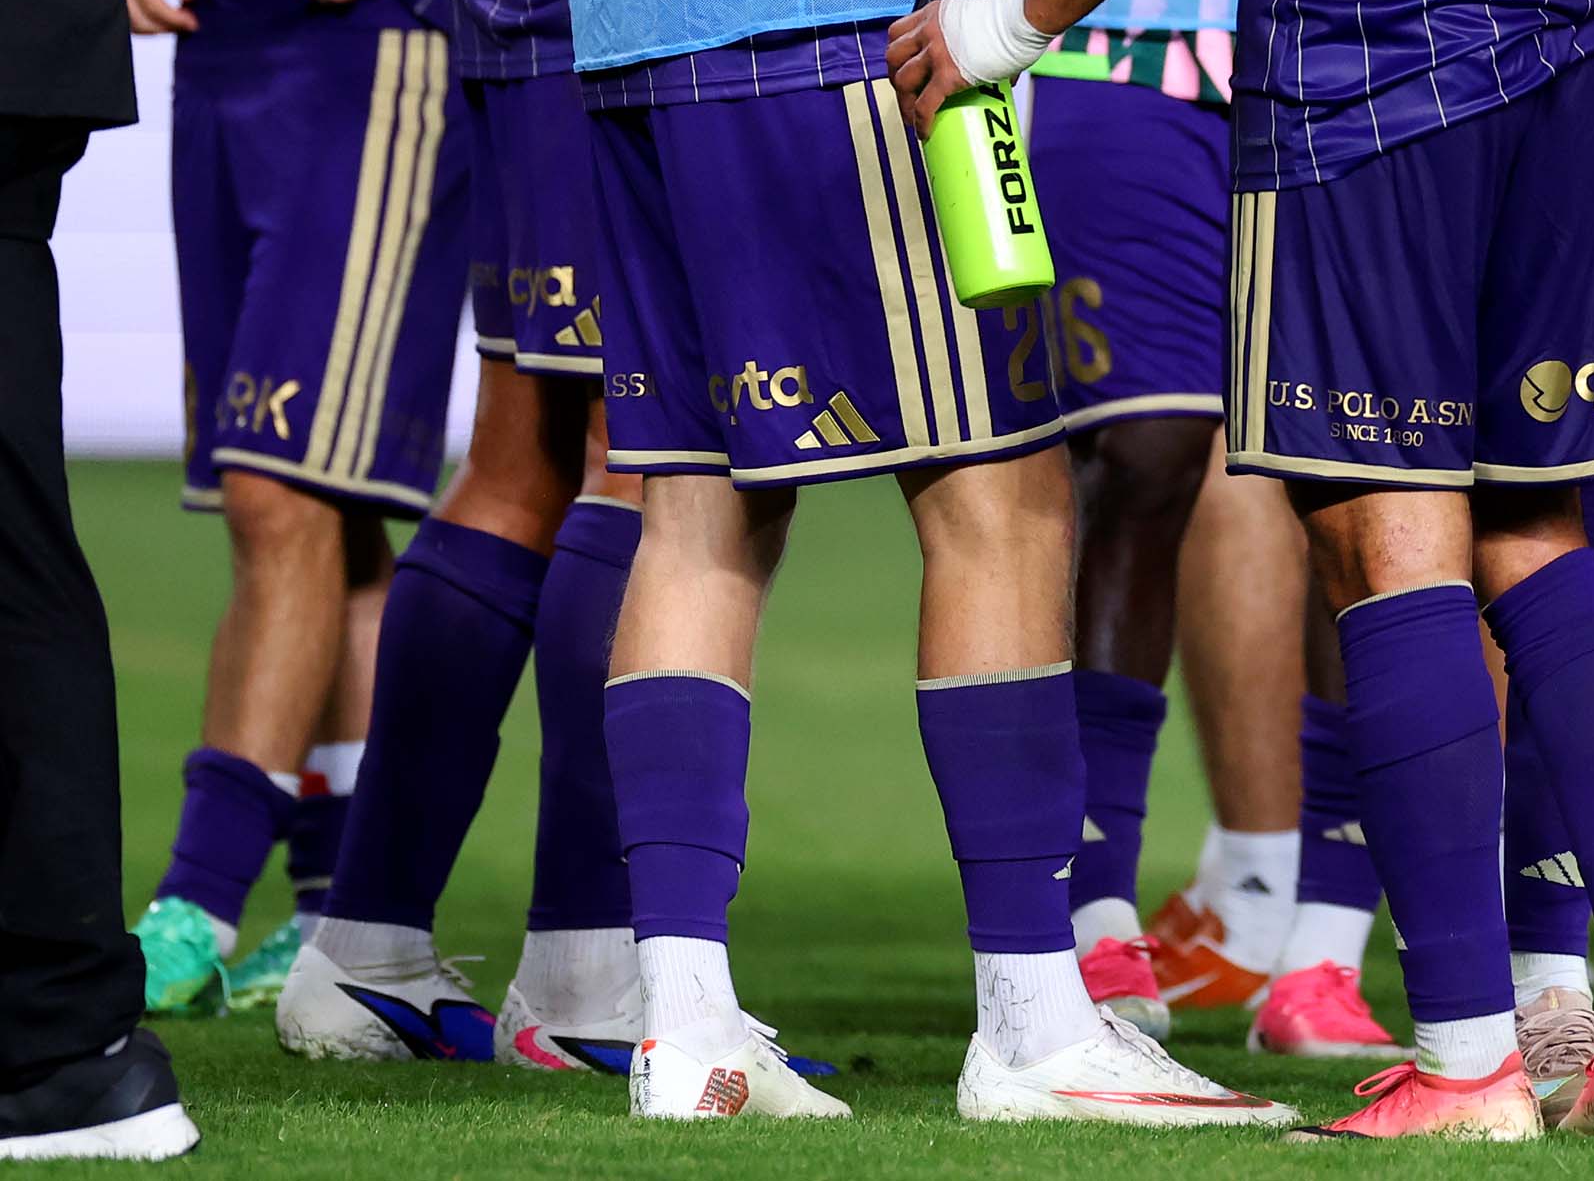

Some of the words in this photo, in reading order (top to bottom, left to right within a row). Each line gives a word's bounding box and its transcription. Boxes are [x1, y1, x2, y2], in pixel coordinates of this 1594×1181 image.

[1268, 379, 1318, 411] U.S.
[1327, 389, 1400, 420] POLO
[1330, 421, 1380, 442] SINCE
[1383, 426, 1424, 448] 1890
